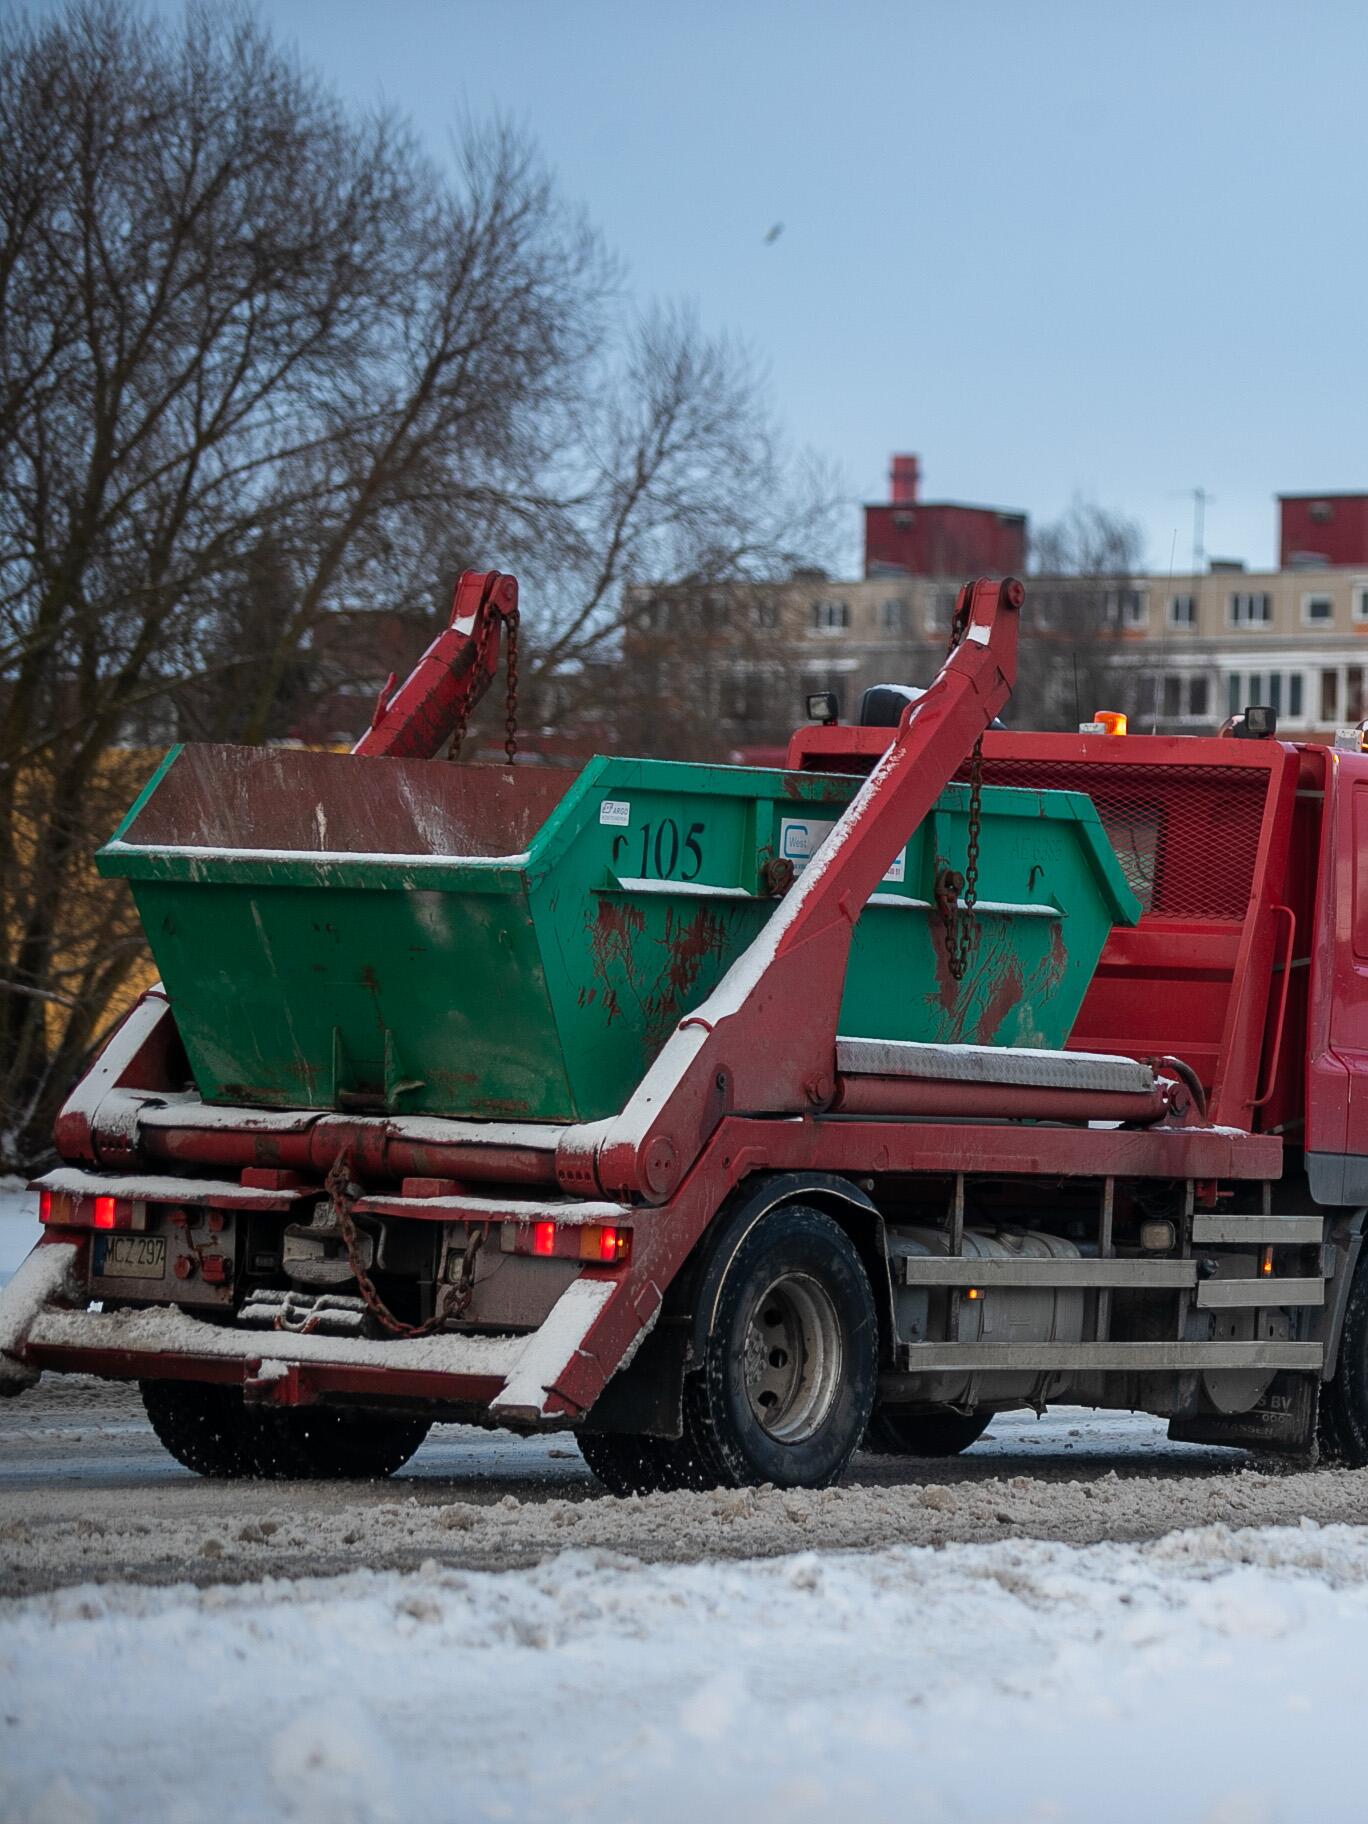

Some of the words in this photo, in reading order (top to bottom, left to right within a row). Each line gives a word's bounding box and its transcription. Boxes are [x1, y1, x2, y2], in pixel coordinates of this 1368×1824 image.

[639, 818, 705, 881] 105
[104, 1238, 134, 1264] MCZ
[138, 1239, 163, 1265] 297
